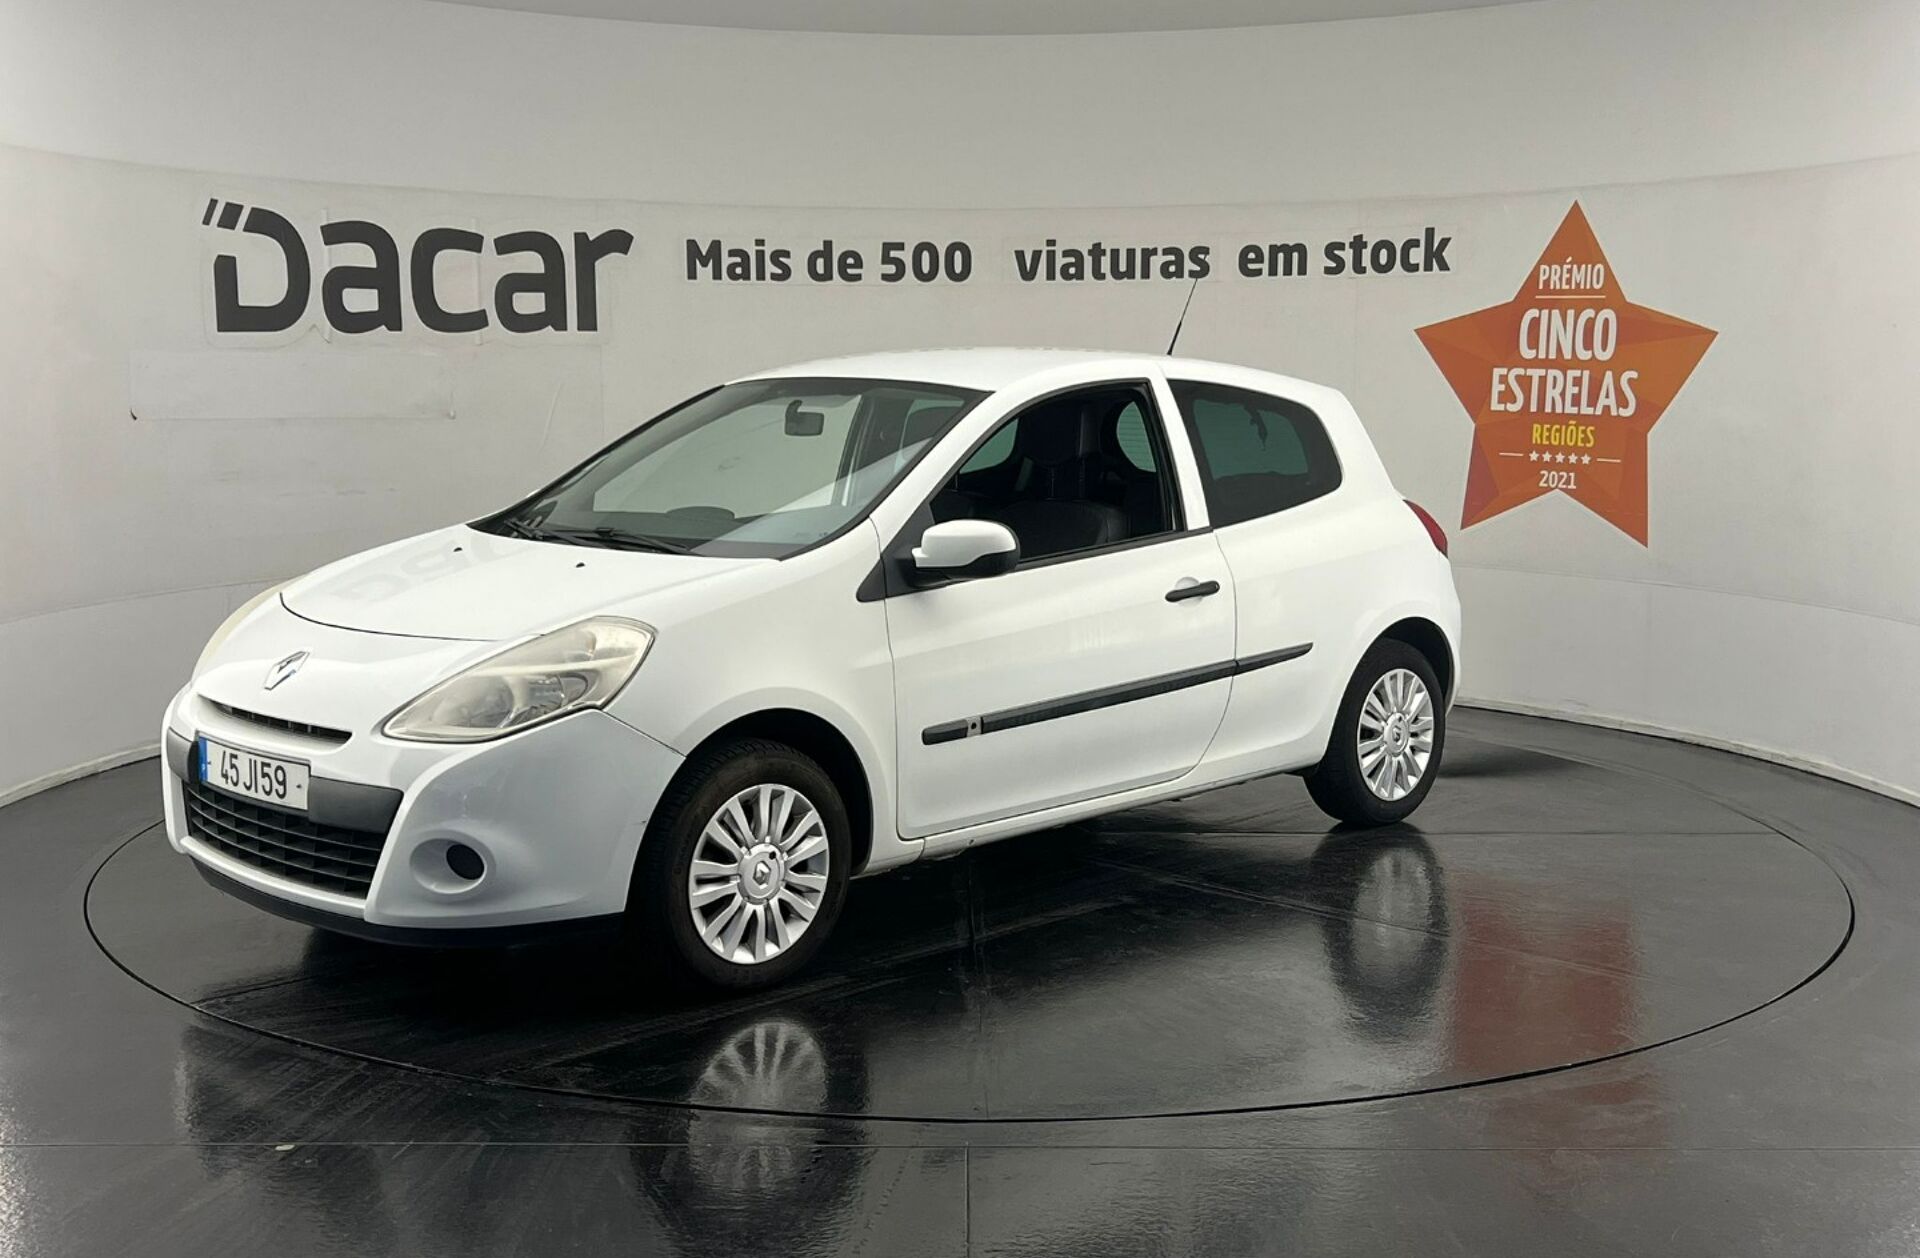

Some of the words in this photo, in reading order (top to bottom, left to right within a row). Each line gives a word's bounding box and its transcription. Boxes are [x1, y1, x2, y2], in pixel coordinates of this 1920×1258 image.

[203, 198, 633, 333] Dacar
[686, 239, 792, 281] Mais
[807, 240, 864, 282] de
[880, 241, 972, 282] 500
[1014, 239, 1210, 281] viaturas
[1238, 241, 1308, 278] em
[1323, 227, 1452, 275] stock
[1538, 257, 1605, 290] PRÉMIO
[1519, 308, 1617, 361] CINCO
[1490, 367, 1639, 417] ESTRELAS
[1532, 420, 1596, 447] REGIÕES
[1539, 470, 1577, 489] 2021
